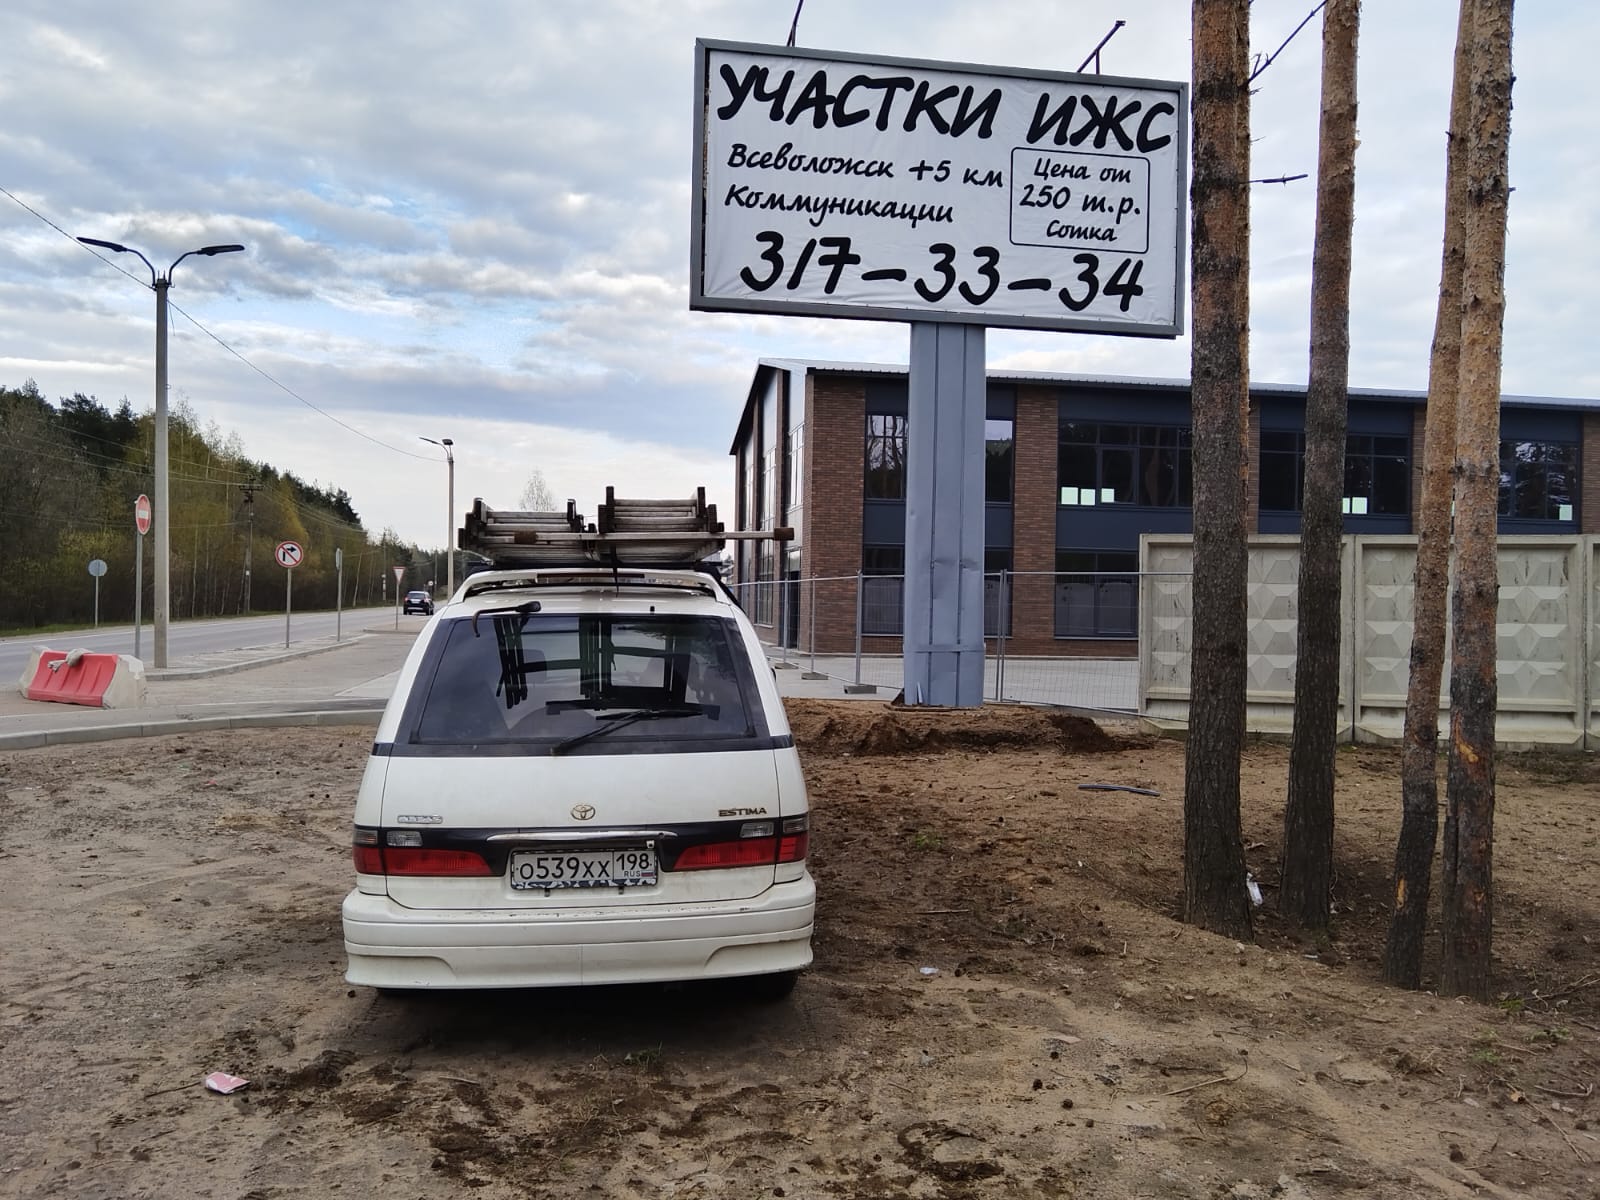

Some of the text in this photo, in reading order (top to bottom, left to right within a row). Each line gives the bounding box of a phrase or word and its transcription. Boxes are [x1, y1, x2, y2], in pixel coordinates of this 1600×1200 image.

[716, 63, 1176, 154] УЧАСТКИ ИЖС
[726, 142, 1004, 188] Всеволожск +5 км
[1033, 157, 1132, 184] Цена от
[724, 183, 954, 229] Коммуникации
[1019, 183, 1141, 225] 250 т.р.
[1046, 219, 1118, 242] Сотка
[739, 230, 1144, 313] 317-33-34
[718, 807, 768, 817] ESTIMA
[616, 853, 650, 870] 198
[623, 870, 641, 878] RUS
